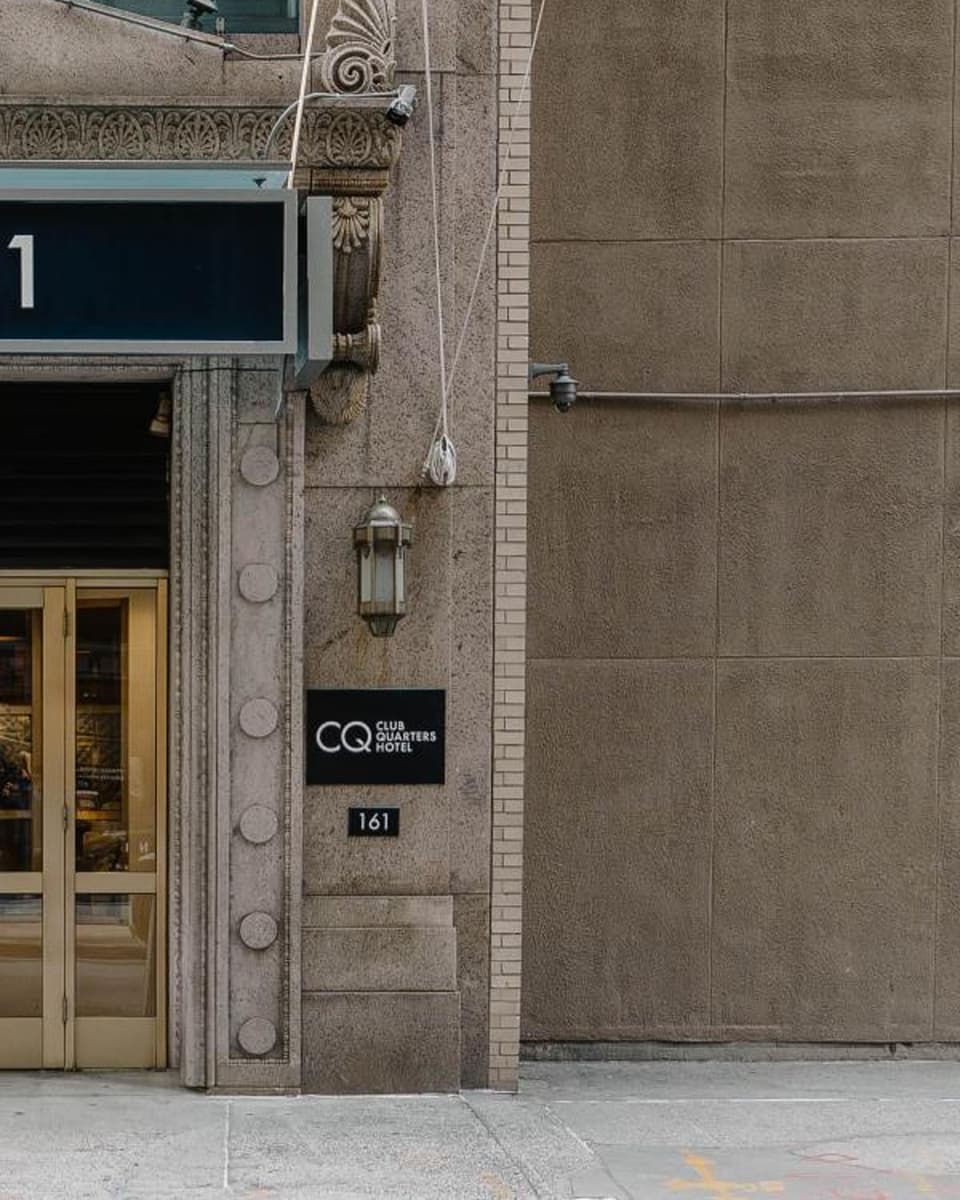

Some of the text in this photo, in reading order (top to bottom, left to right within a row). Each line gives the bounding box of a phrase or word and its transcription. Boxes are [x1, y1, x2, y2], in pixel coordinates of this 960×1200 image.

[375, 720, 405, 730] CLUB
[316, 720, 371, 752] CQ
[375, 730, 436, 742] QUARTERS
[375, 742, 413, 752] HOTEL
[359, 812, 389, 830] 161
